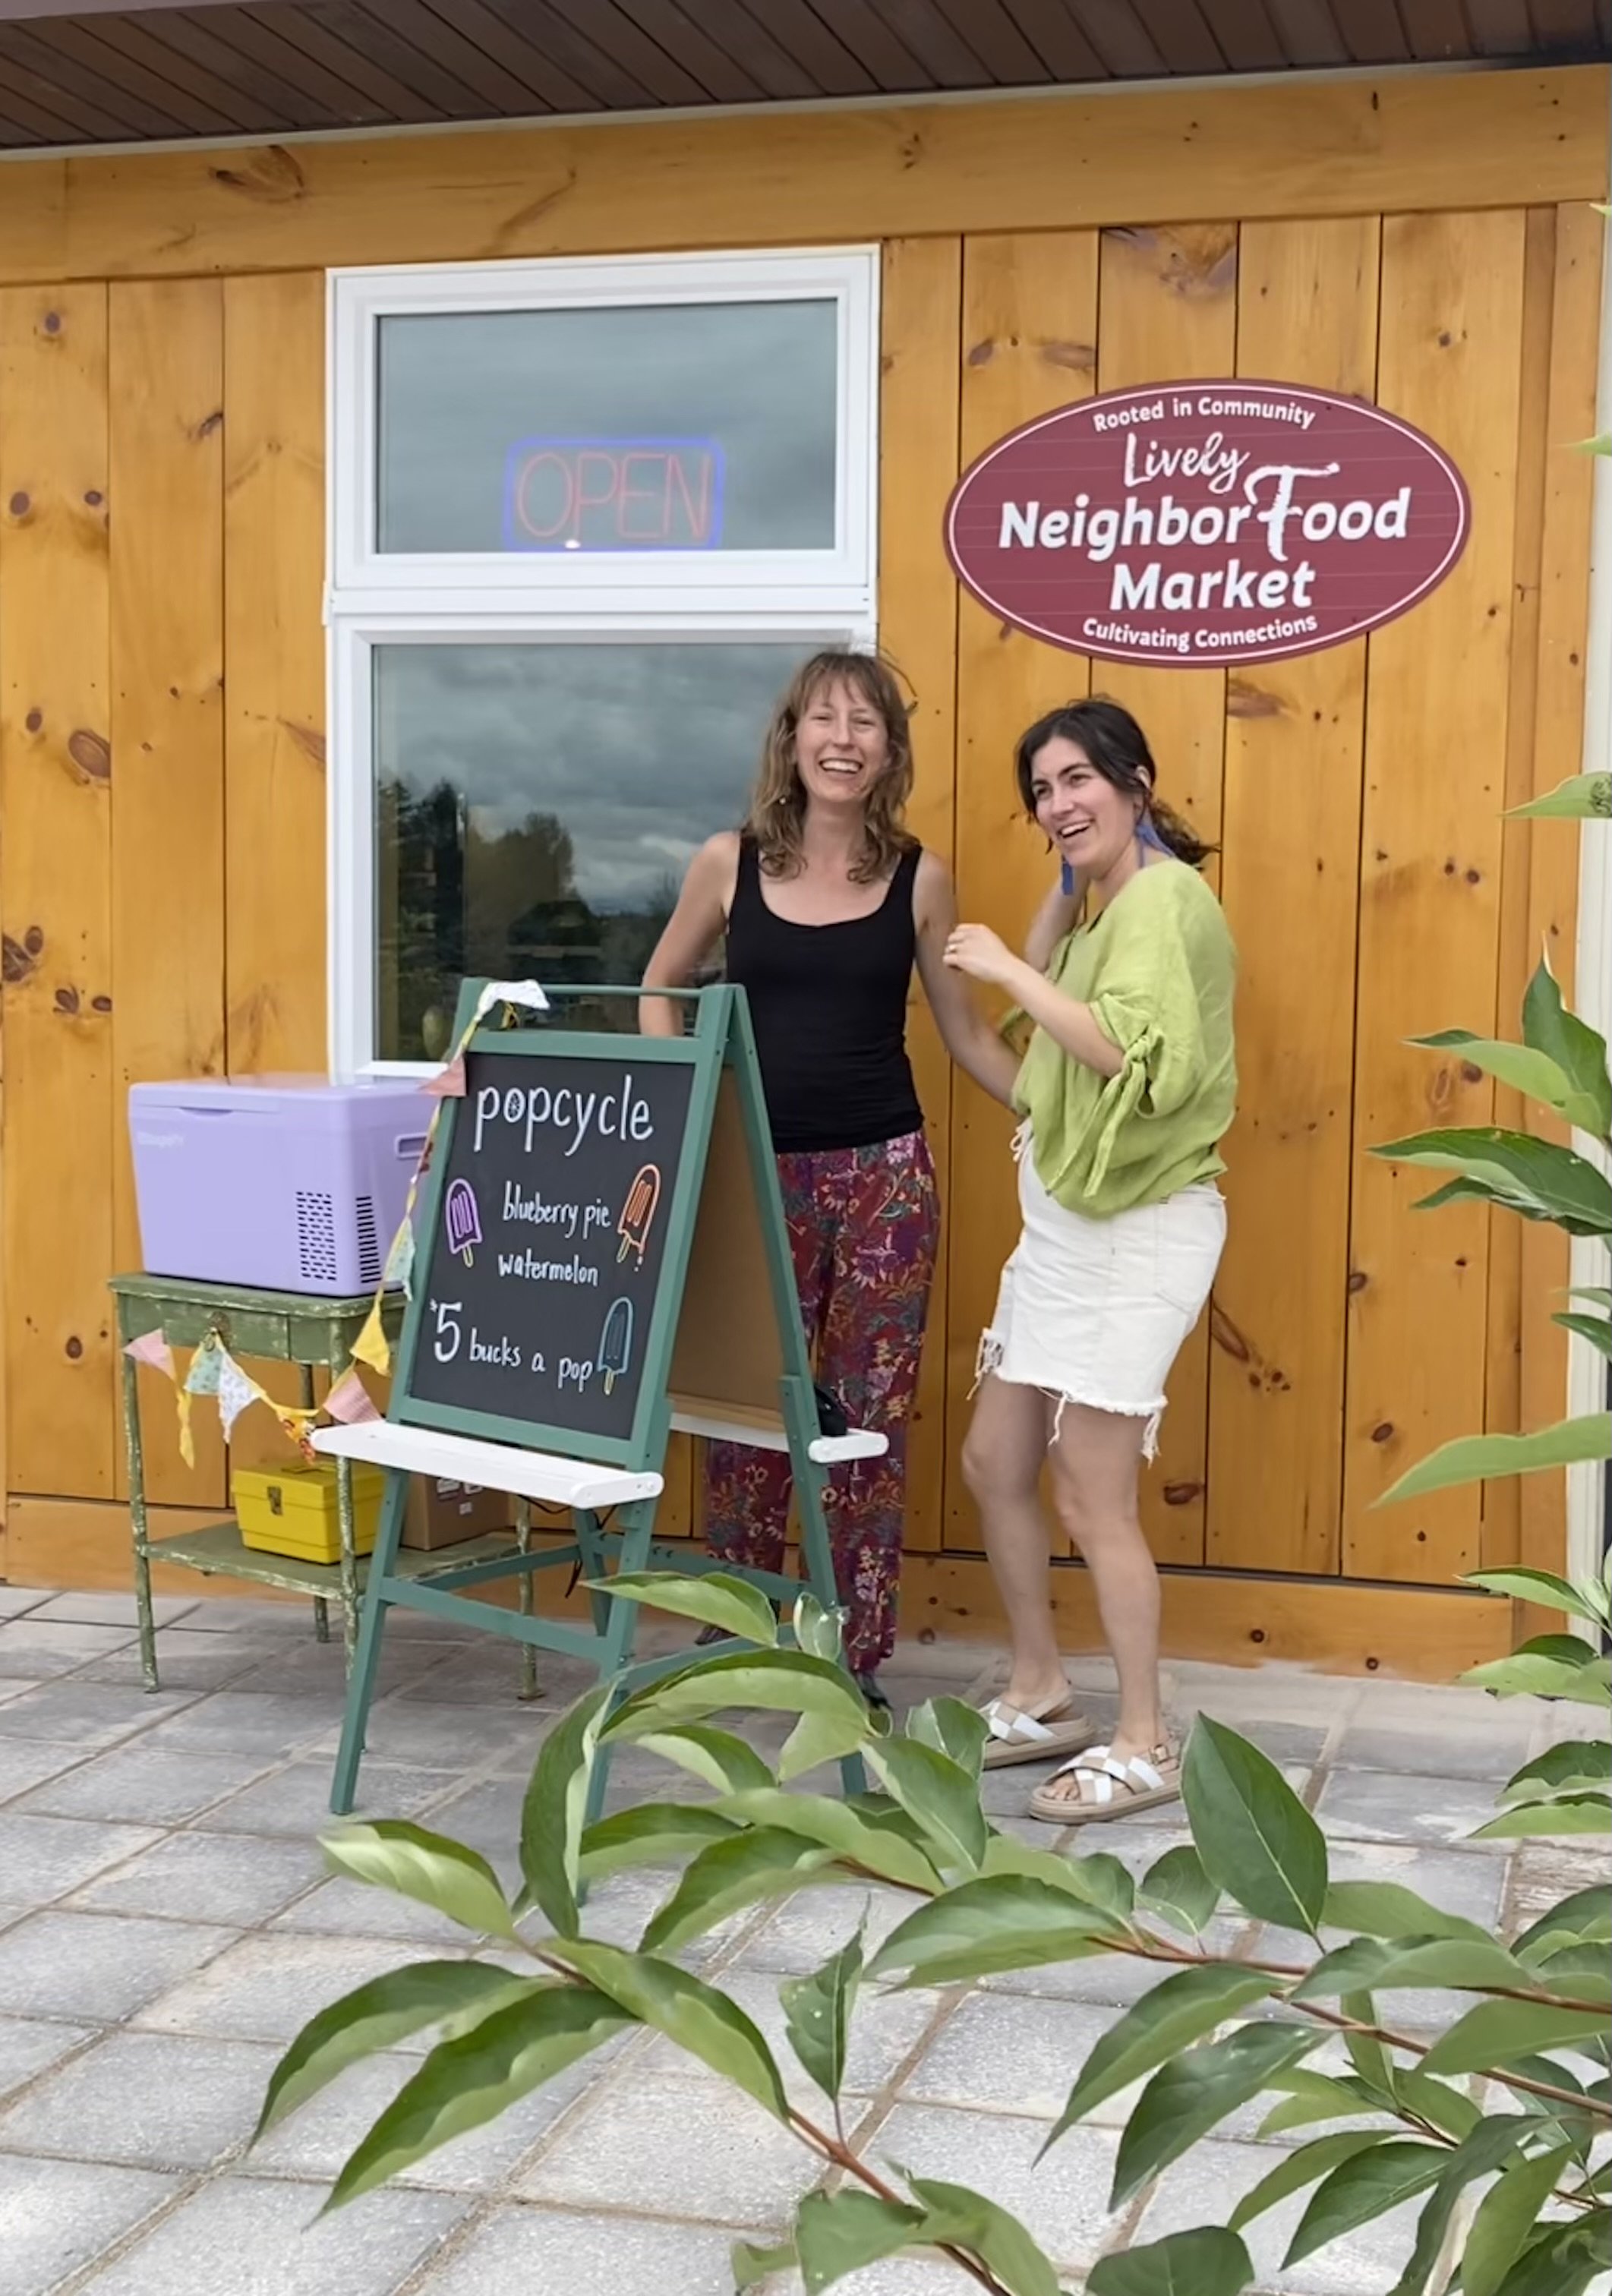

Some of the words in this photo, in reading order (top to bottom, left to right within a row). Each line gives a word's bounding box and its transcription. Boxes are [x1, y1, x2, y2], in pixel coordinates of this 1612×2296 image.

[1093, 401, 1163, 432] Rooted
[1172, 398, 1192, 416] in
[1198, 397, 1315, 430] Community
[1123, 431, 1251, 494] Lively
[518, 451, 712, 541] OPEN
[1109, 559, 1316, 610] Market
[1083, 618, 1189, 653] Cultivating
[1195, 615, 1318, 649] Connections
[473, 1074, 653, 1156] popcycle
[503, 1181, 579, 1238] blueberry
[583, 1198, 611, 1239] pie
[498, 1249, 599, 1287] watermelon
[470, 1327, 522, 1367] bucks
[532, 1353, 545, 1372] a
[557, 1356, 593, 1392] pop
